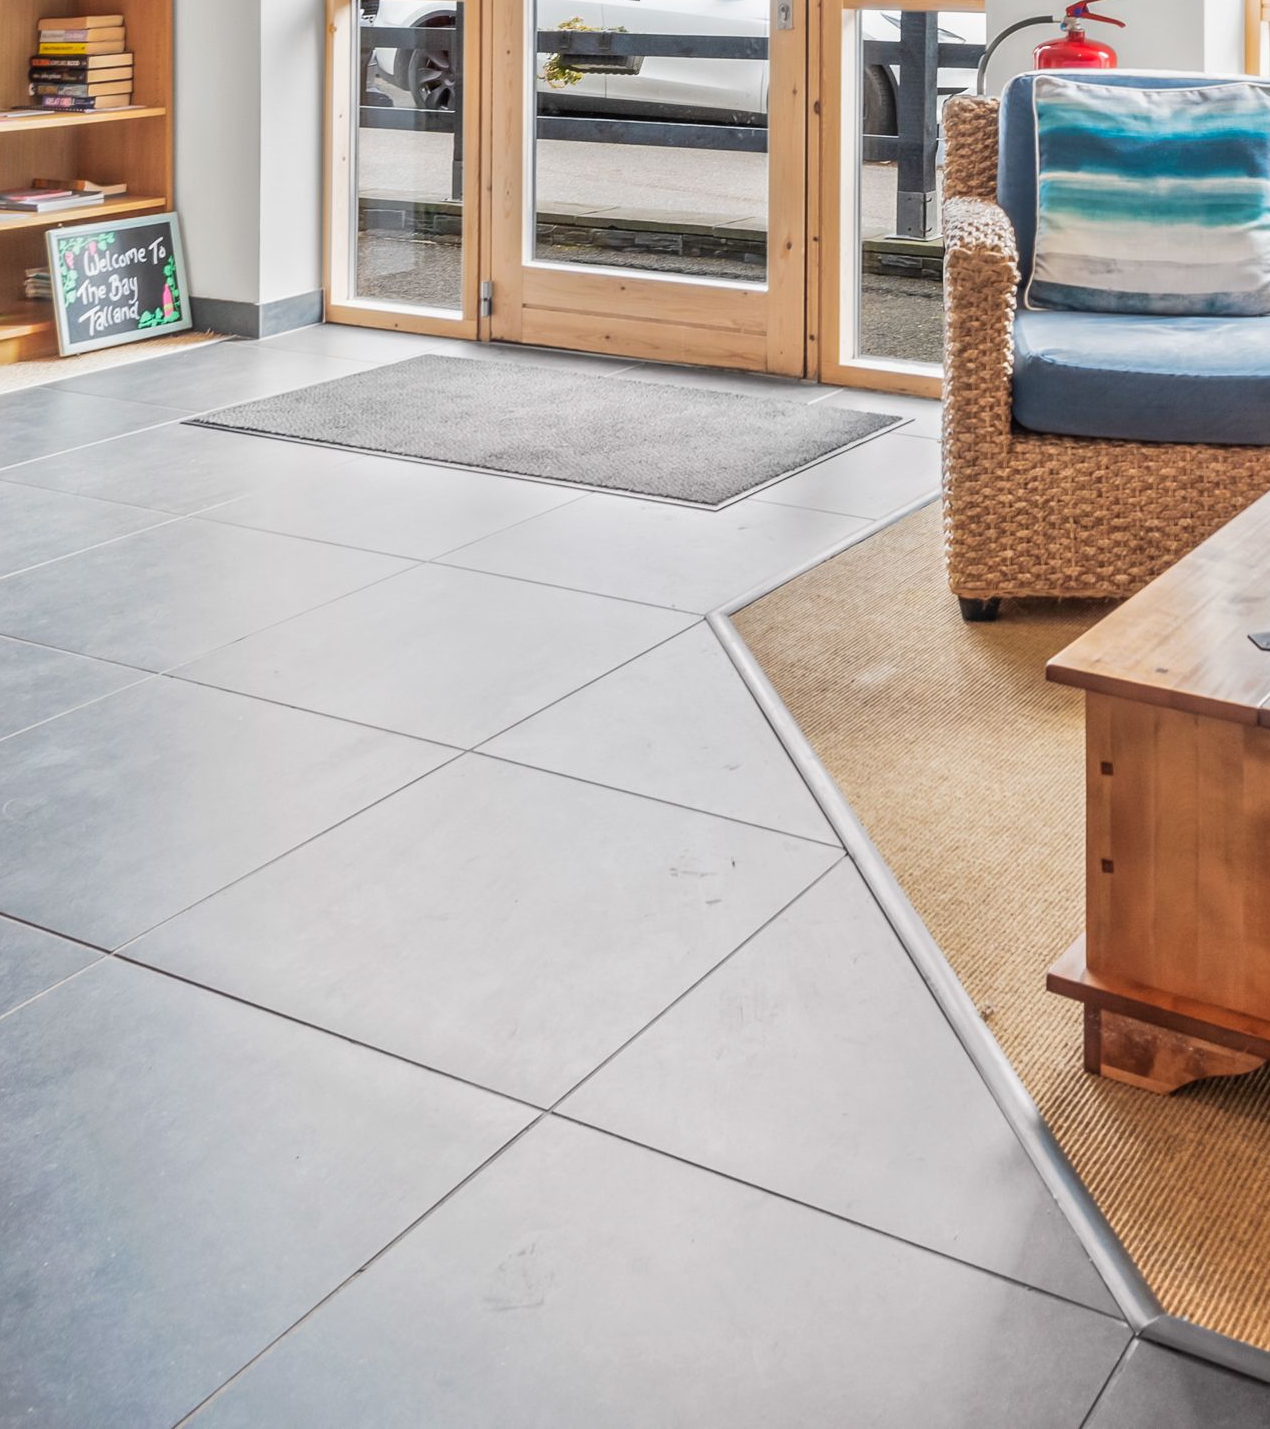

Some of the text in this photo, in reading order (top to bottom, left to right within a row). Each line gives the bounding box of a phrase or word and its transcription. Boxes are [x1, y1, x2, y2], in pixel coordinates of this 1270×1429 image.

[84, 236, 167, 276] Welcome To
[76, 273, 139, 305] The Bay
[78, 301, 140, 336] Talland
